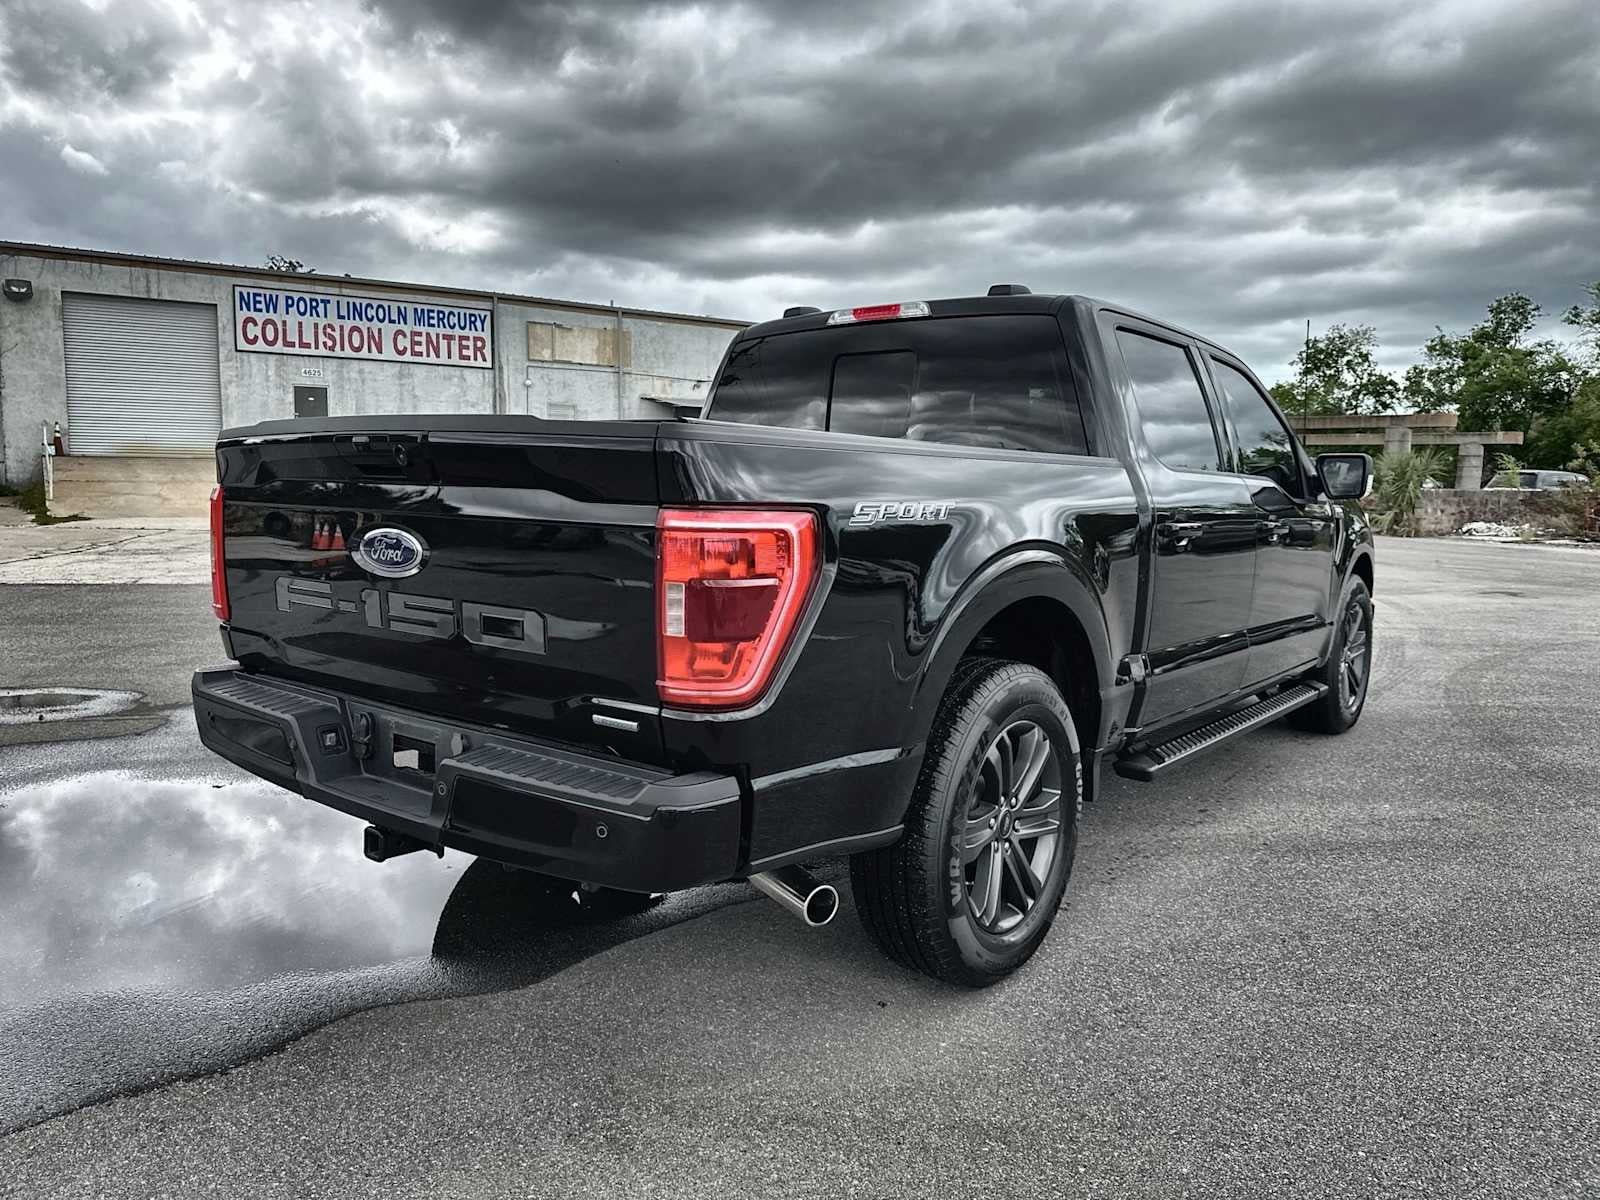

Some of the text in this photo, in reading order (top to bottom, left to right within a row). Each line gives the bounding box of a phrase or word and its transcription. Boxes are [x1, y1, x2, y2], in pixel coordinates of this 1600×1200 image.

[238, 291, 488, 332] NEW PORT LINCOLN MERCURY
[241, 316, 487, 362] COLLISION CENTER
[302, 369, 322, 377] 4625
[849, 501, 956, 526] SPORT
[370, 536, 405, 562] Ford
[274, 576, 548, 655] F-150
